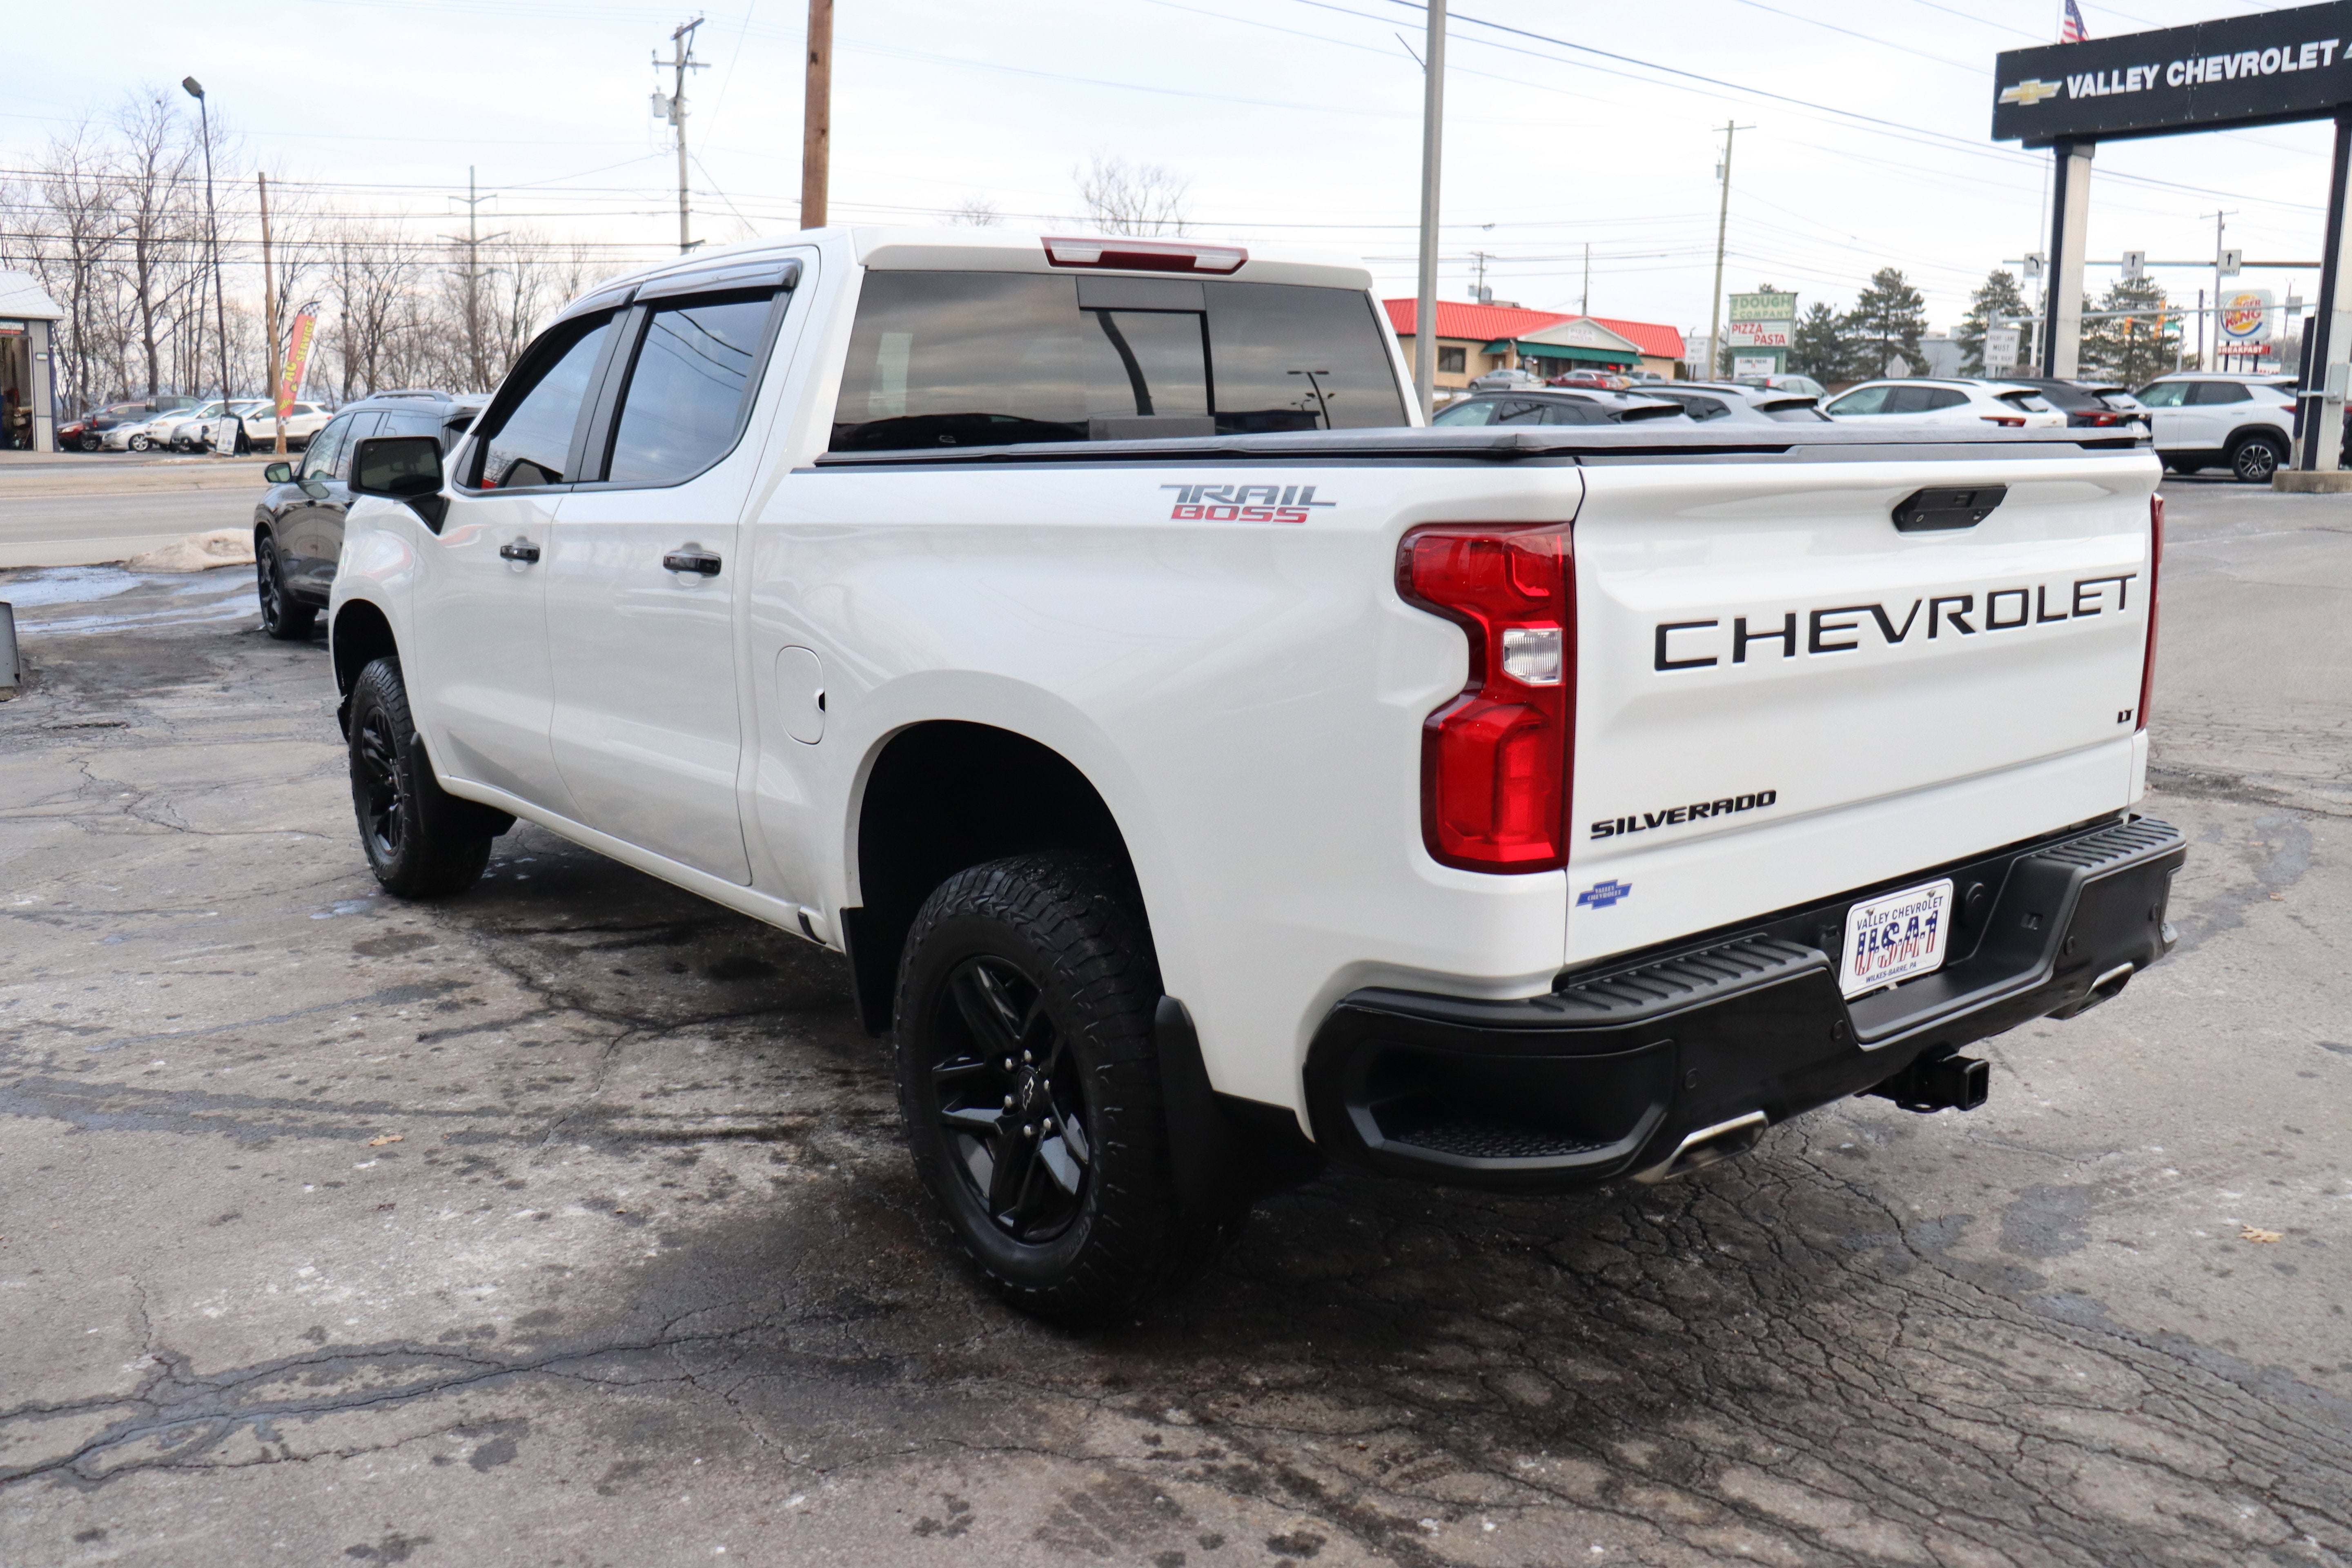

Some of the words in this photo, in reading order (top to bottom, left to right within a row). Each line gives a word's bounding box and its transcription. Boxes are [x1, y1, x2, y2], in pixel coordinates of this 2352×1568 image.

[2066, 64, 2160, 100] VALLEY
[2166, 38, 2339, 88] CHEVROLET
[1740, 296, 1791, 308] DOUGH
[1732, 323, 1762, 334] PIZZA
[296, 320, 314, 362] SERVICE
[1754, 334, 1785, 345] PASTA
[1160, 484, 1337, 507] TRAIL
[1171, 505, 1310, 523] BOSS
[1654, 573, 2137, 671] CHEVROLET
[2117, 709, 2134, 724] LT
[1590, 789, 1777, 840] SILVERADO
[1587, 889, 1622, 901] CHEVROLET
[1595, 885, 1615, 893] VALLEY
[1857, 911, 1890, 931] VALLEY
[1892, 896, 1944, 920] CHEVROLET
[1865, 965, 1908, 983] WILKES-BARRE,
